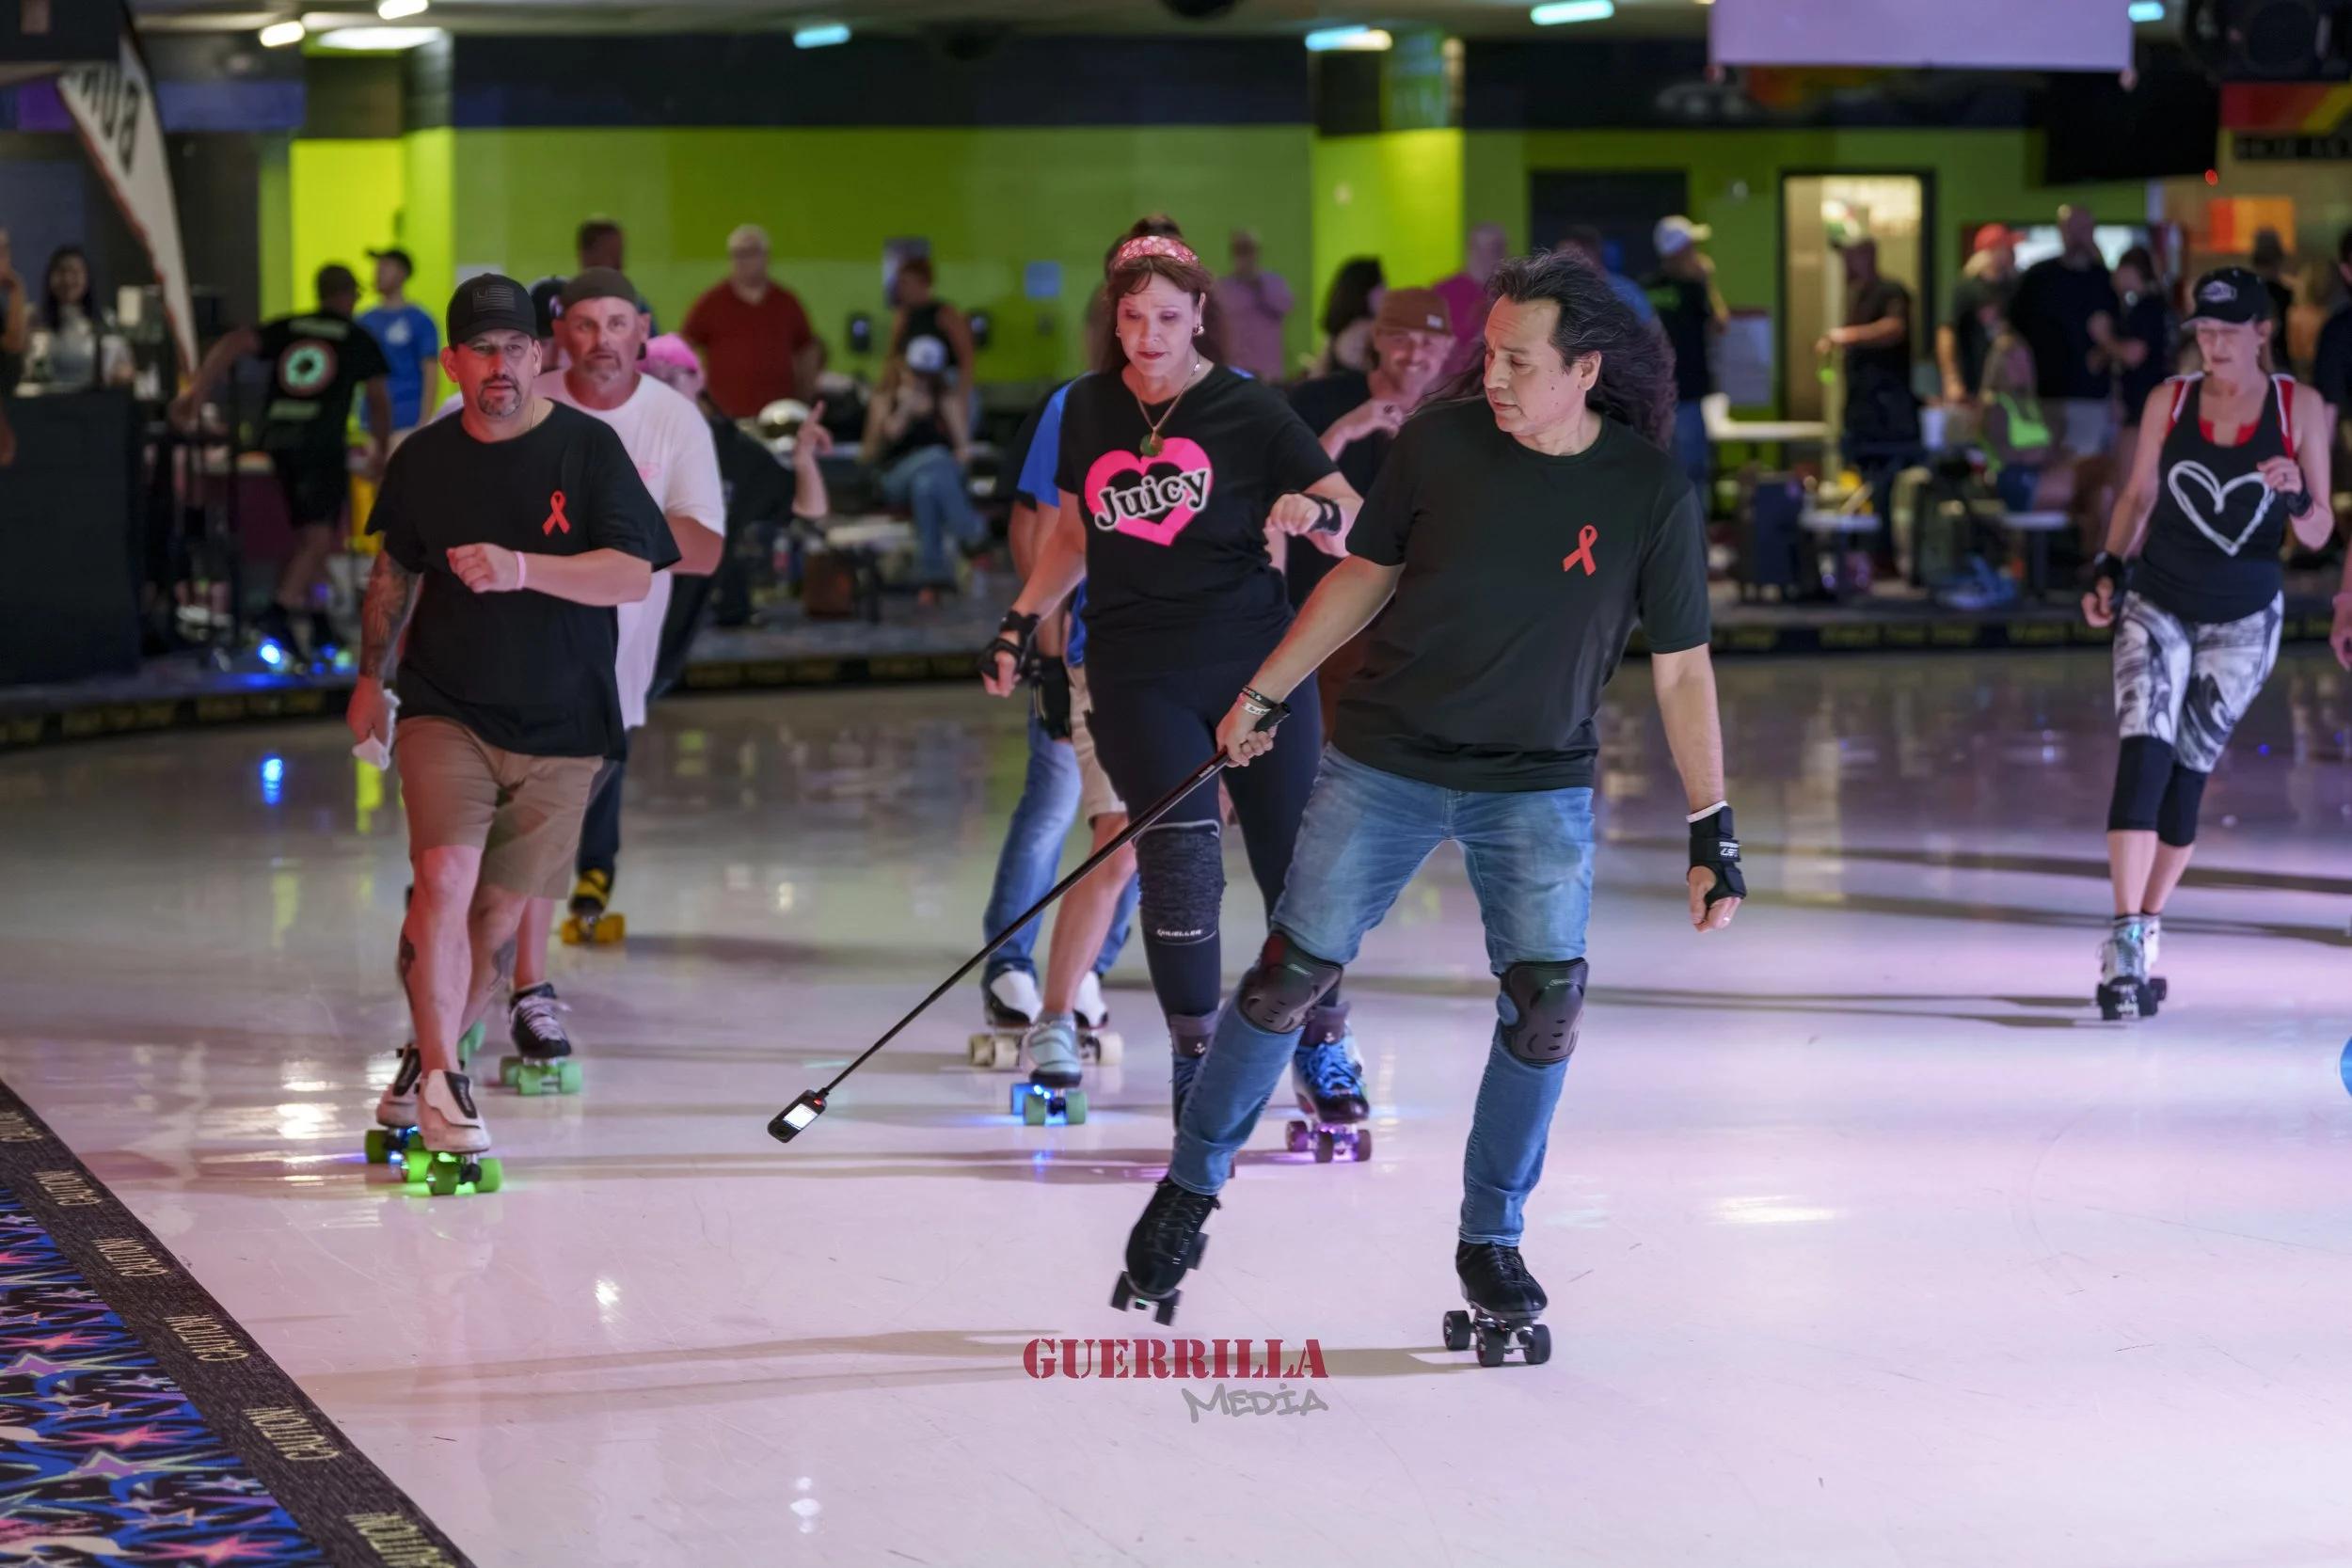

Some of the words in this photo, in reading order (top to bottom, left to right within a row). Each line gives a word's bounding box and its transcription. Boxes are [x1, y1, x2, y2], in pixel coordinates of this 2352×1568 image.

[1095, 468, 1210, 531] Juicy
[32, 1170, 103, 1205] CAUTION
[91, 1237, 169, 1276] CAUTION
[163, 1314, 249, 1361] CAUTION
[242, 1405, 342, 1460] CAUTION
[343, 1511, 457, 1568] AUTION
